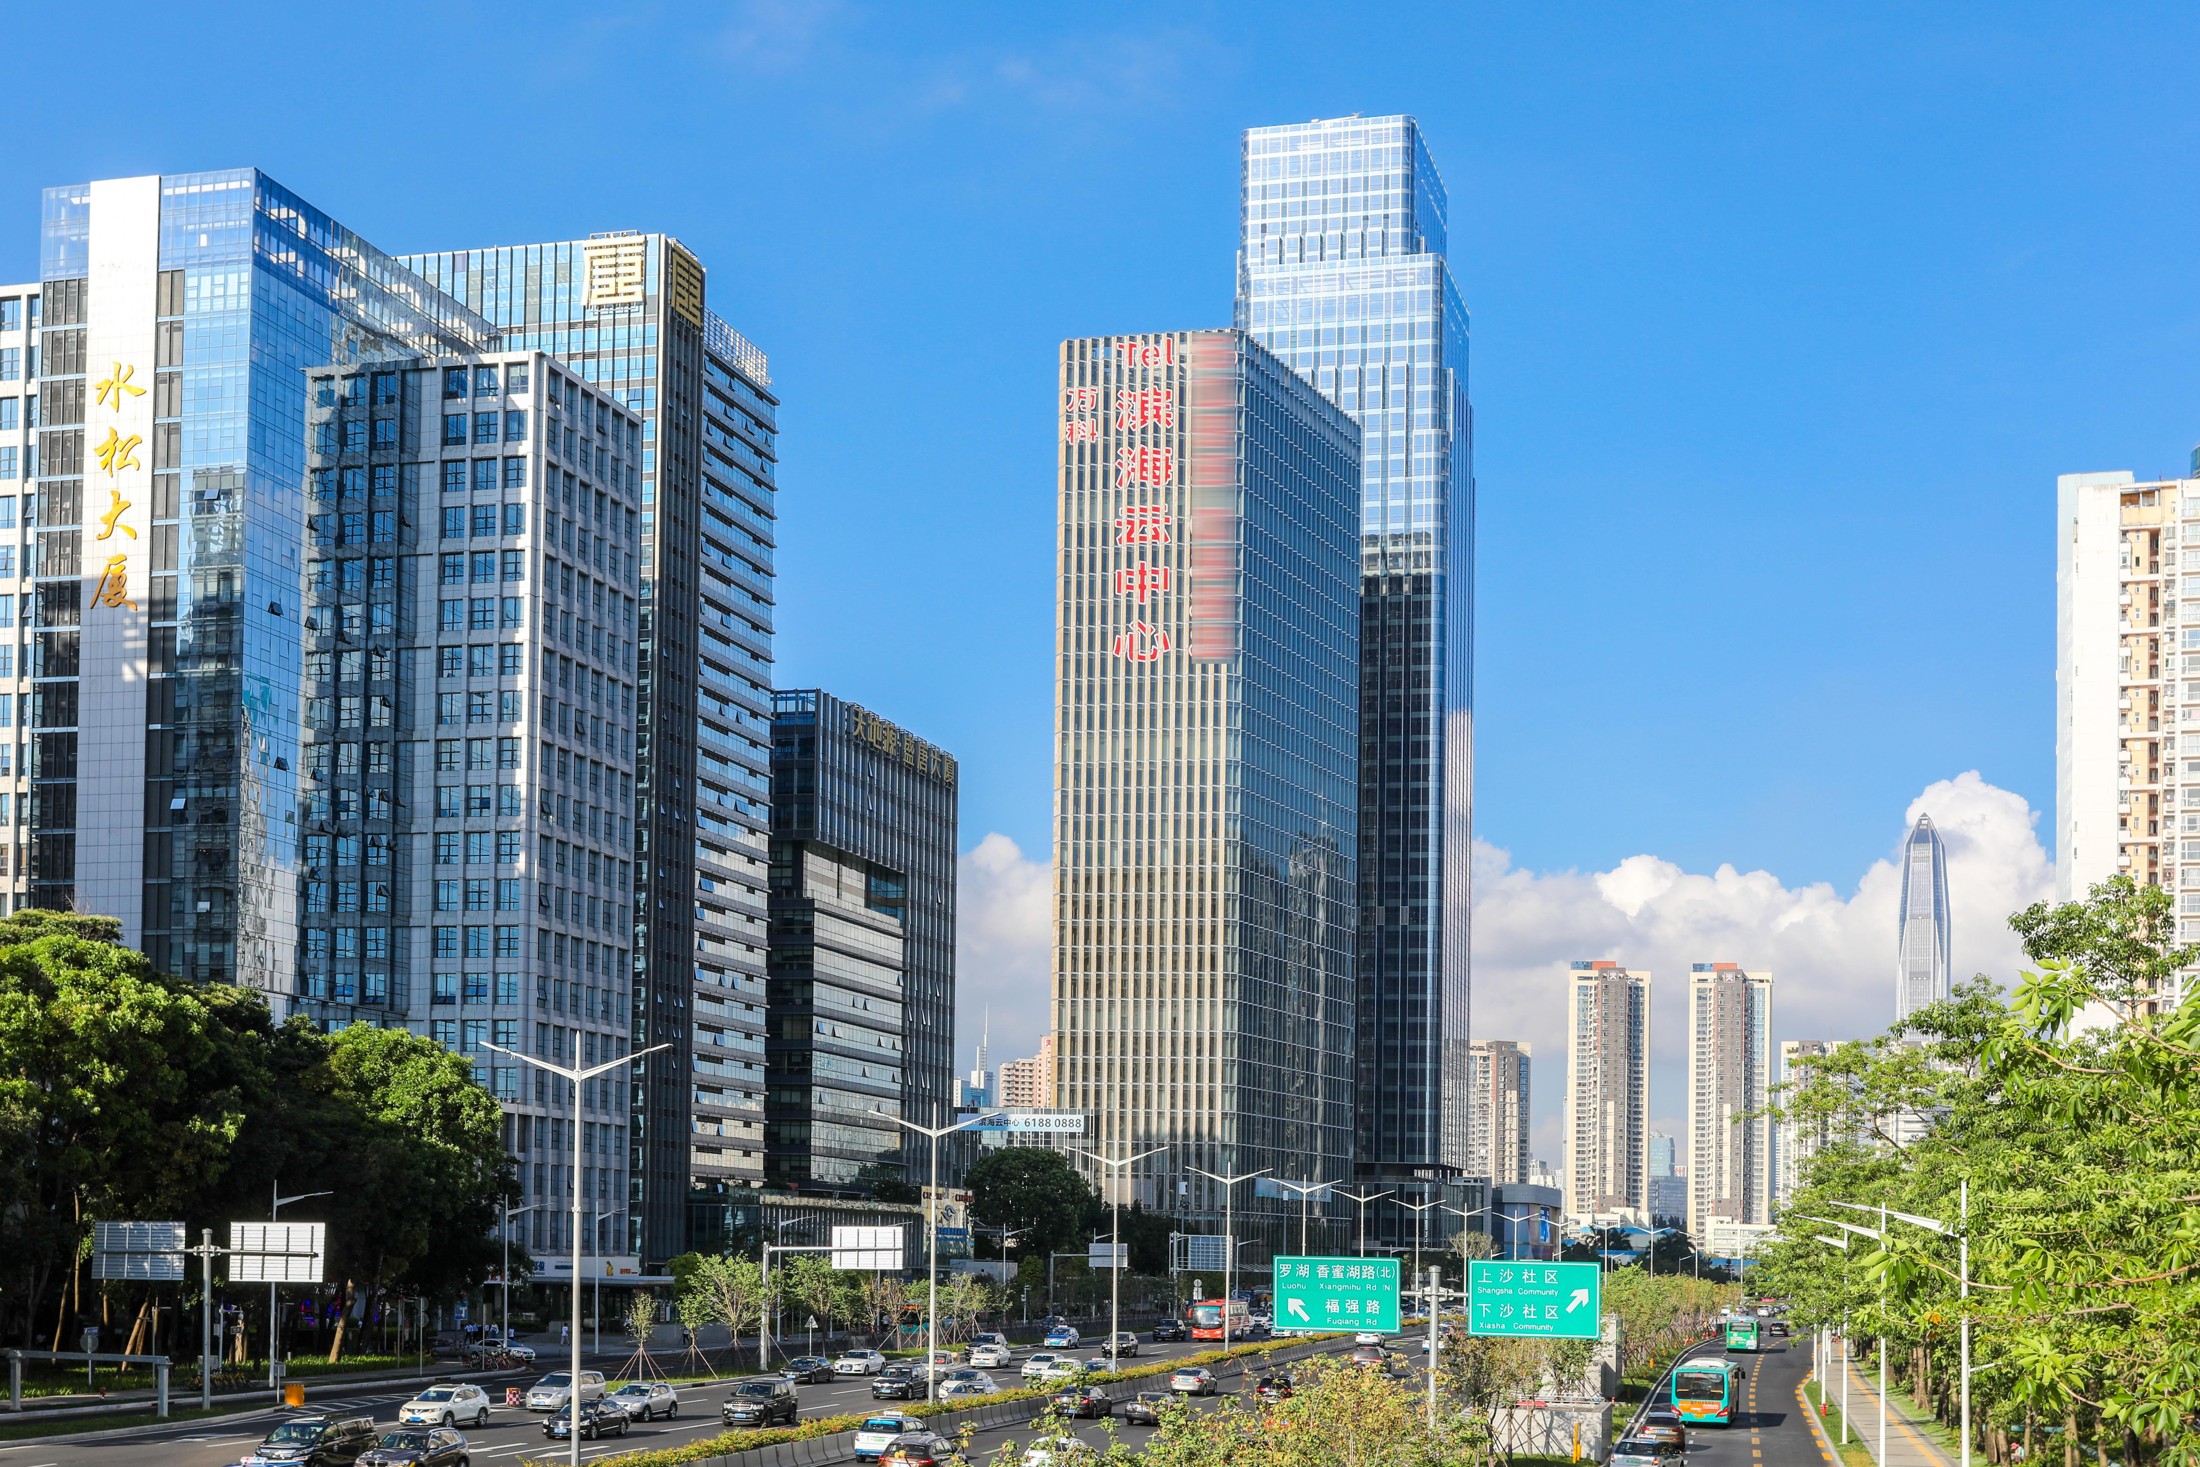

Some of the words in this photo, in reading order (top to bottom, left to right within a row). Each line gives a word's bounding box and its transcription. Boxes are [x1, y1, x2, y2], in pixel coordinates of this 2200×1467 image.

[1066, 387, 1097, 444] 万科
[90, 361, 146, 610] 水松大厦
[1115, 385, 1173, 662] 滨海云中心
[1024, 1117, 1052, 1128] 6188
[1054, 1118, 1082, 1128] 0888
[1279, 1264, 1310, 1278] 罗湖
[1477, 1269, 1559, 1285] 上沙社区
[1282, 1282, 1307, 1290] Luohu
[1319, 1283, 1361, 1292] Xiangmihu
[1477, 1286, 1513, 1297] Shangsha
[1518, 1287, 1559, 1298] Community
[1325, 1298, 1381, 1315] 福强路
[1477, 1304, 1560, 1320] 下沙社区
[1326, 1317, 1360, 1327] Fuqiang
[1366, 1318, 1378, 1326] Rd
[1479, 1321, 1506, 1330] Xiasha
[1513, 1321, 1554, 1333] Community
